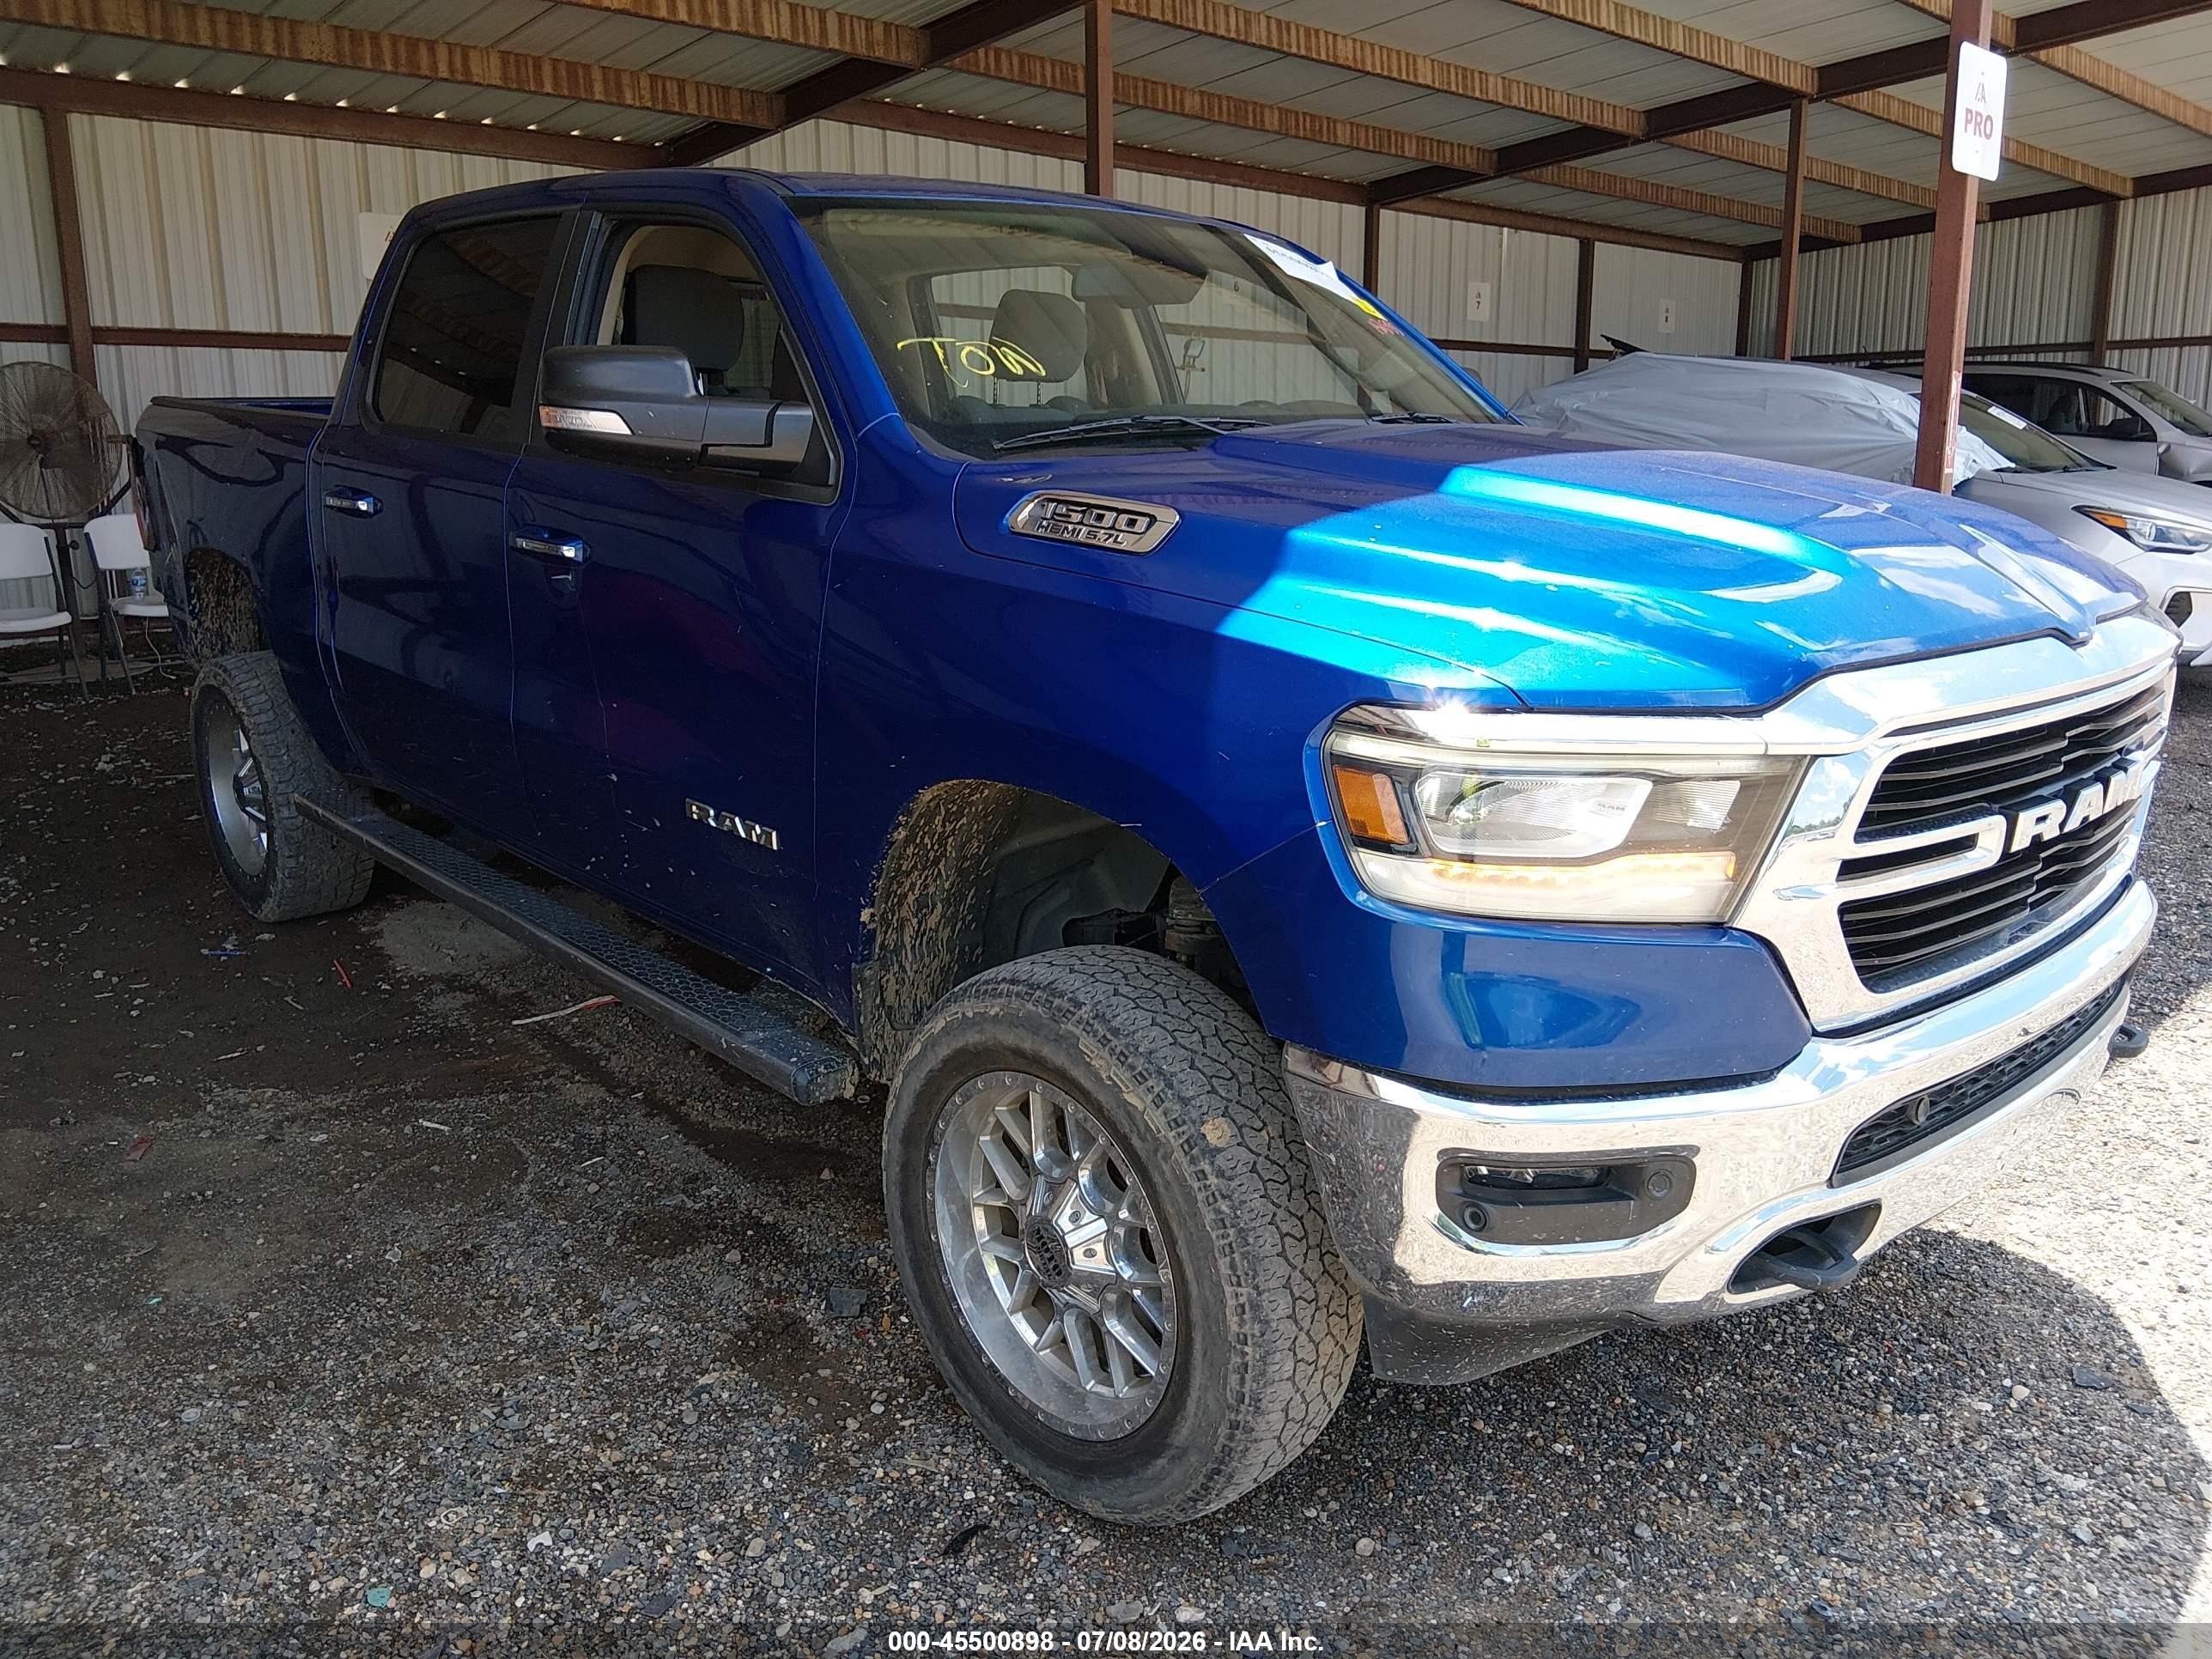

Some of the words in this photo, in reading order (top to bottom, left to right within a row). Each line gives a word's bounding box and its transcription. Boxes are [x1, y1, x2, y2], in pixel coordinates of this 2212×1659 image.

[1965, 108, 1994, 140] PRO
[1475, 301, 1482, 310] 7
[1041, 501, 1150, 533] 1500
[1036, 520, 1082, 539] HEMI
[1084, 529, 1127, 547] 5.7L
[2008, 752, 2144, 853] RAM
[684, 797, 779, 851] RAM
